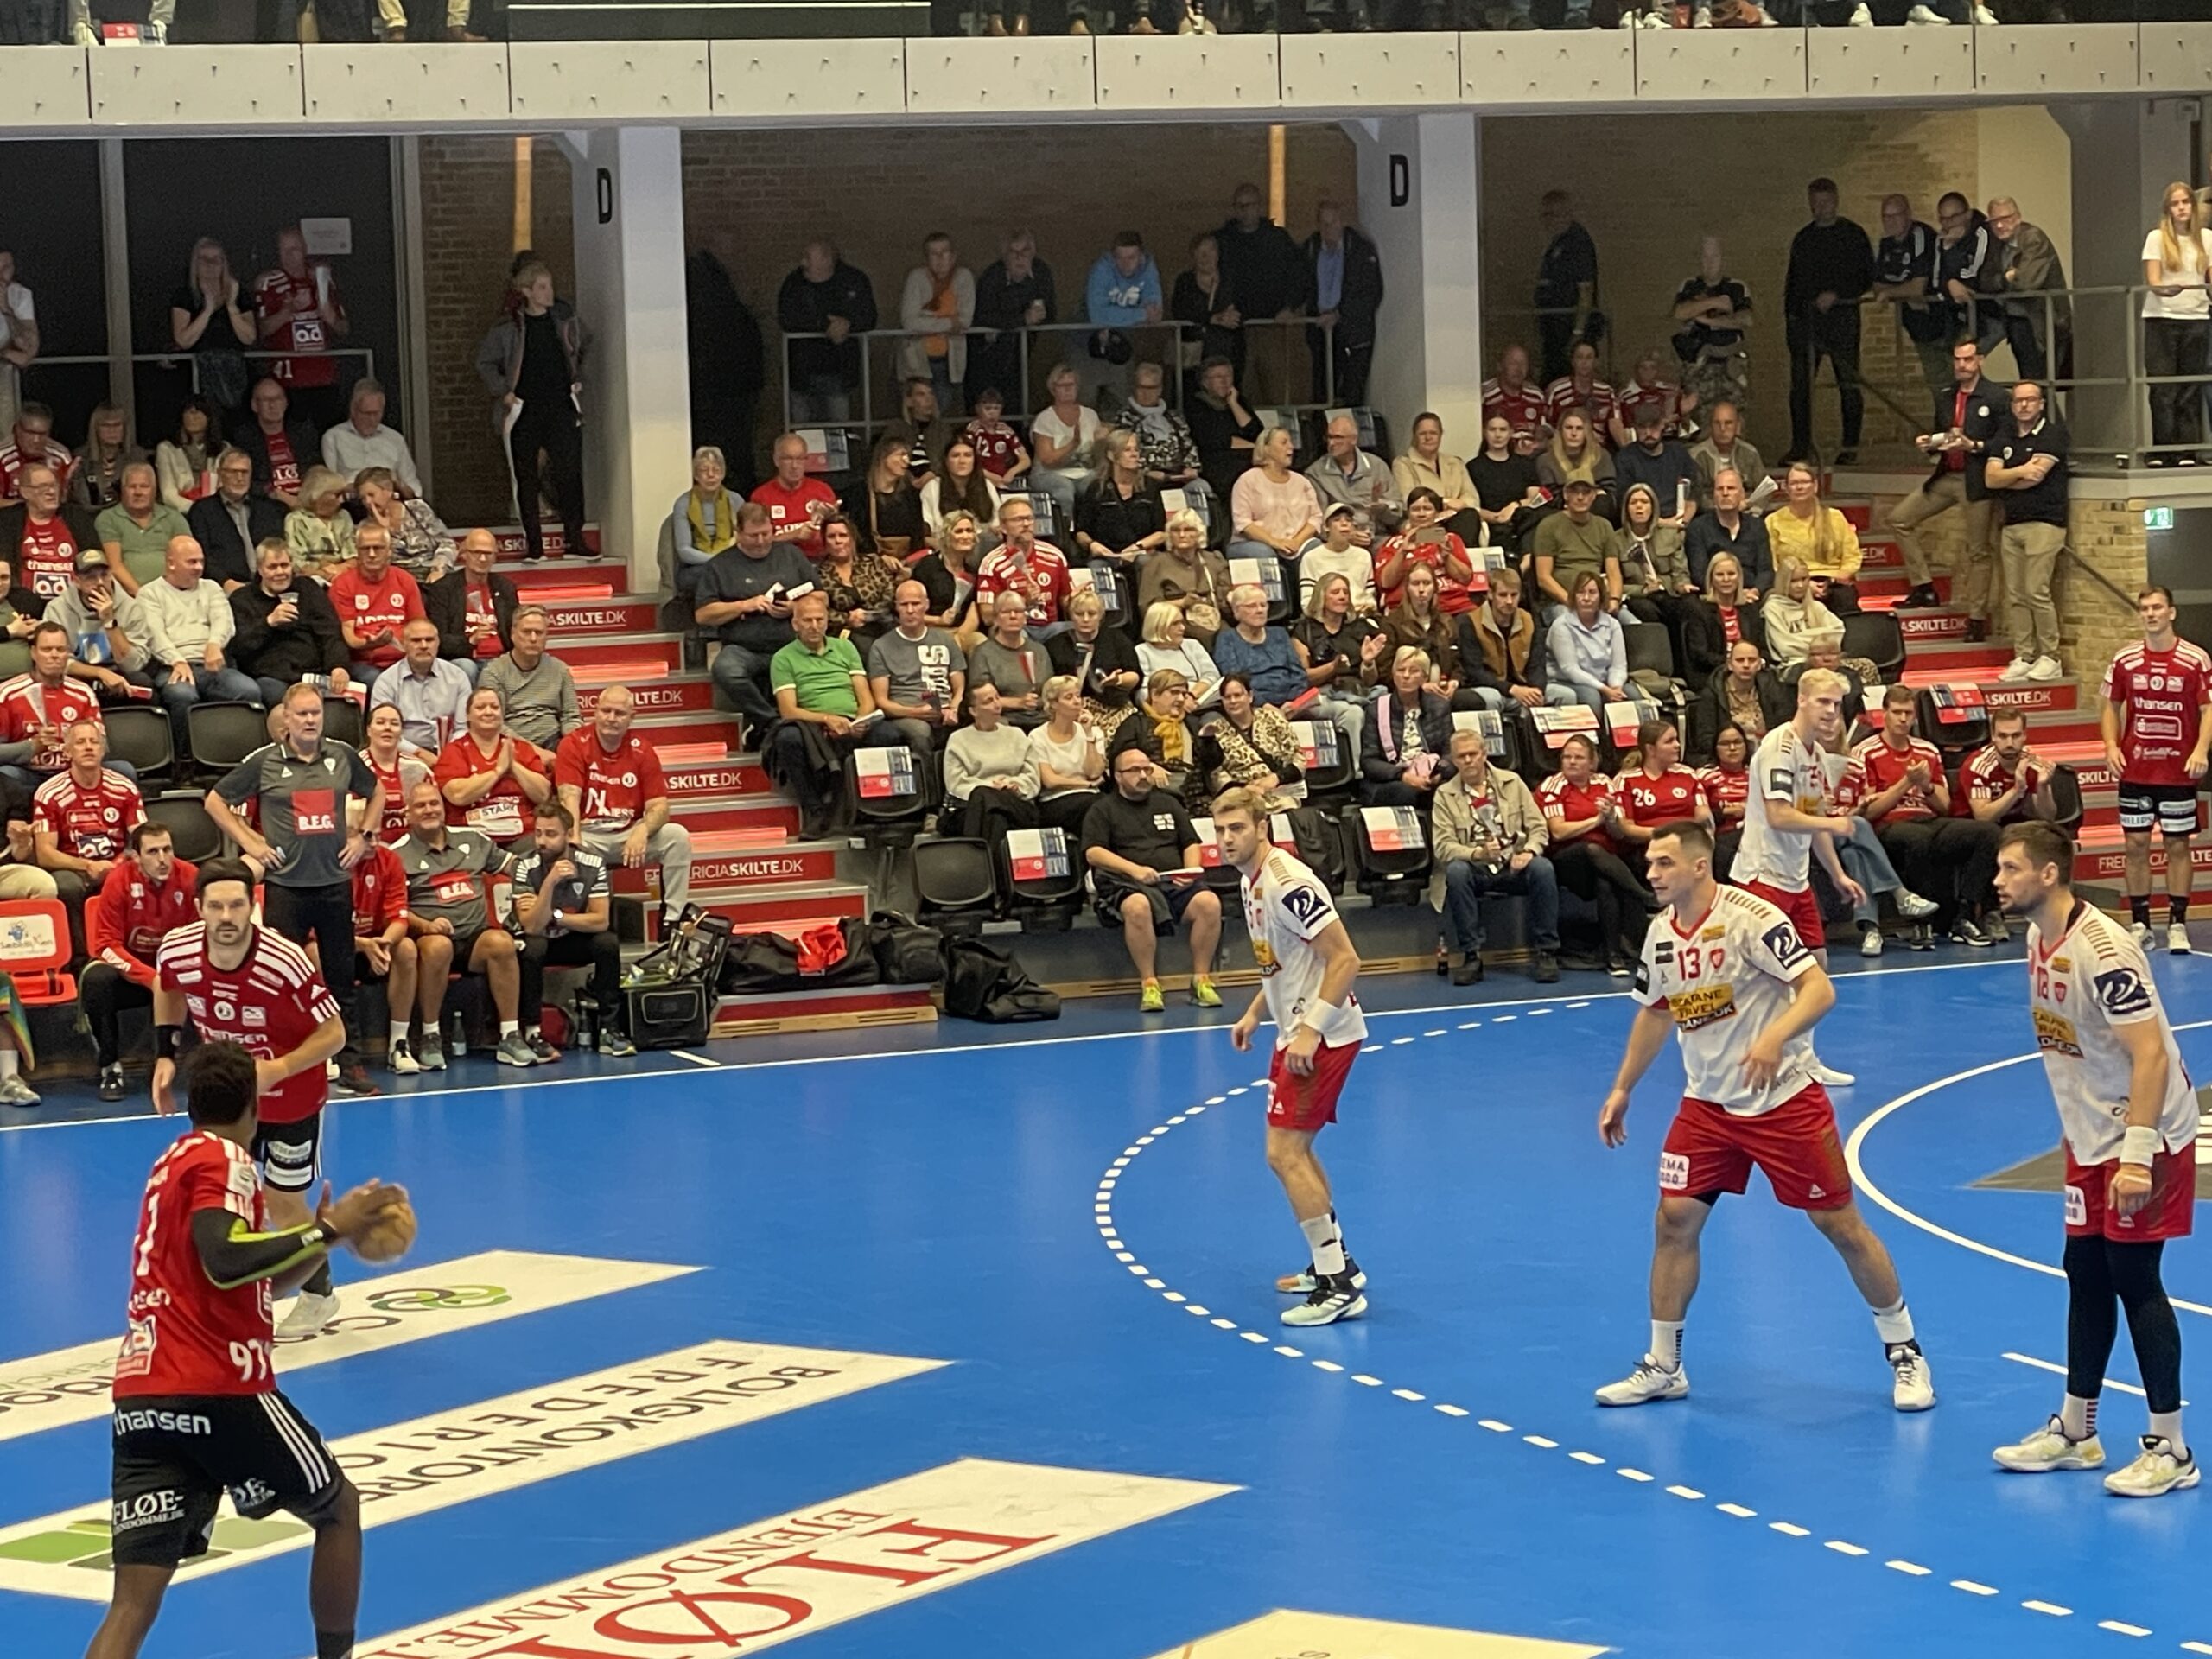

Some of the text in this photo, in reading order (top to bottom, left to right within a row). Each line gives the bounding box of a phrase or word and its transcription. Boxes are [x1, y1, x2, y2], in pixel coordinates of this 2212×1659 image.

[597, 168, 613, 224] D
[1389, 154, 1409, 207] D
[1632, 787, 1656, 807] 26
[1678, 947, 1701, 982] 13
